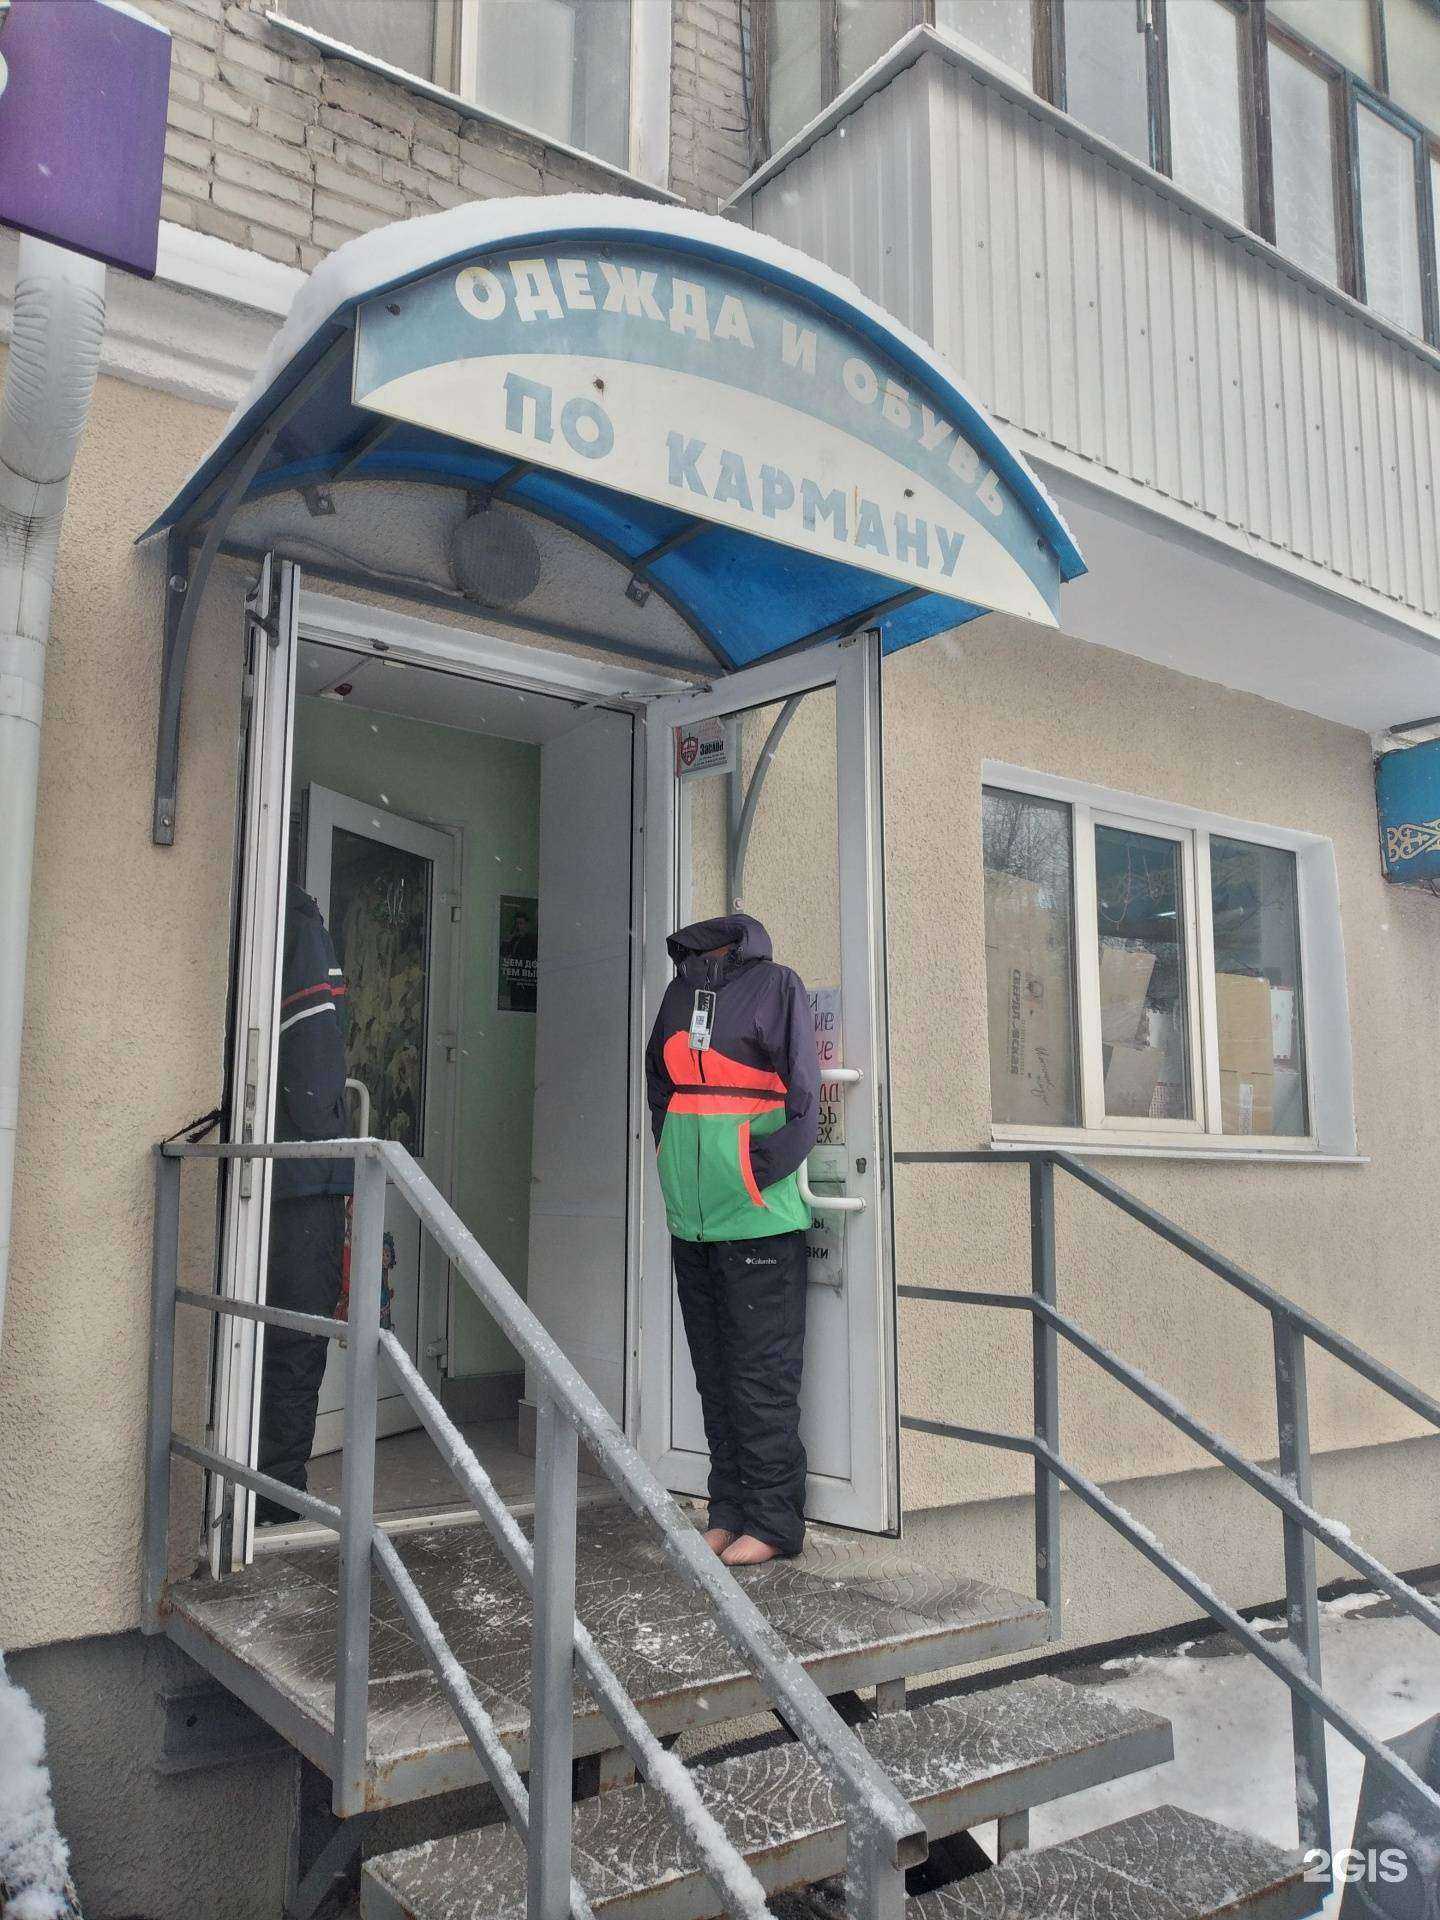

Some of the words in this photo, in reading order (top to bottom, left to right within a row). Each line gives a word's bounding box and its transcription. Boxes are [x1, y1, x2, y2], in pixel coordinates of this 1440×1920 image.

[455, 258, 754, 349] ОДЕЖДА
[782, 318, 816, 373] И
[841, 358, 1007, 518] ОБУВЬ
[503, 371, 615, 460] ПО
[666, 430, 966, 578] КАРМАНУ
